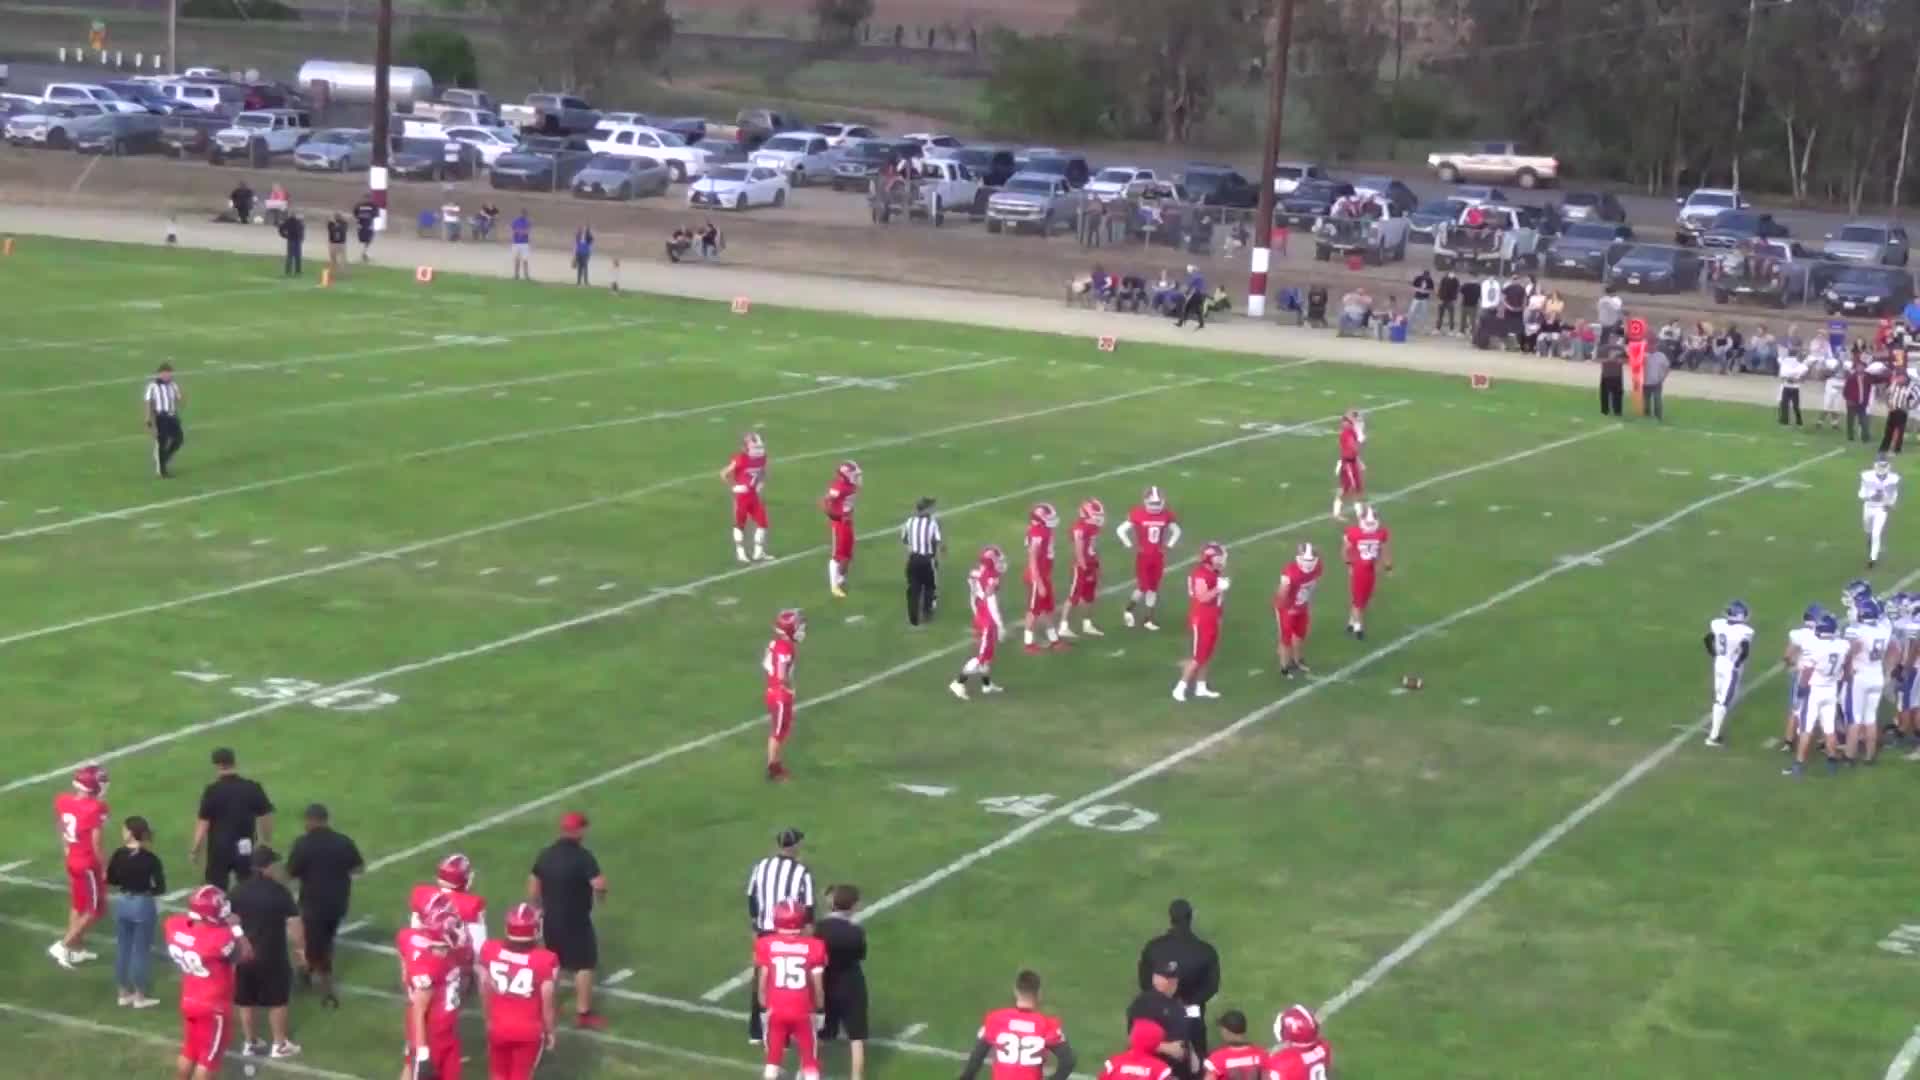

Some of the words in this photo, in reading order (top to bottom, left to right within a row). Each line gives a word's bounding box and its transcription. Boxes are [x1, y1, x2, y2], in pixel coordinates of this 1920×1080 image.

[977, 793, 1160, 832] 40
[489, 960, 534, 998] 54
[771, 955, 807, 990] 15
[996, 1031, 1045, 1066] 32
